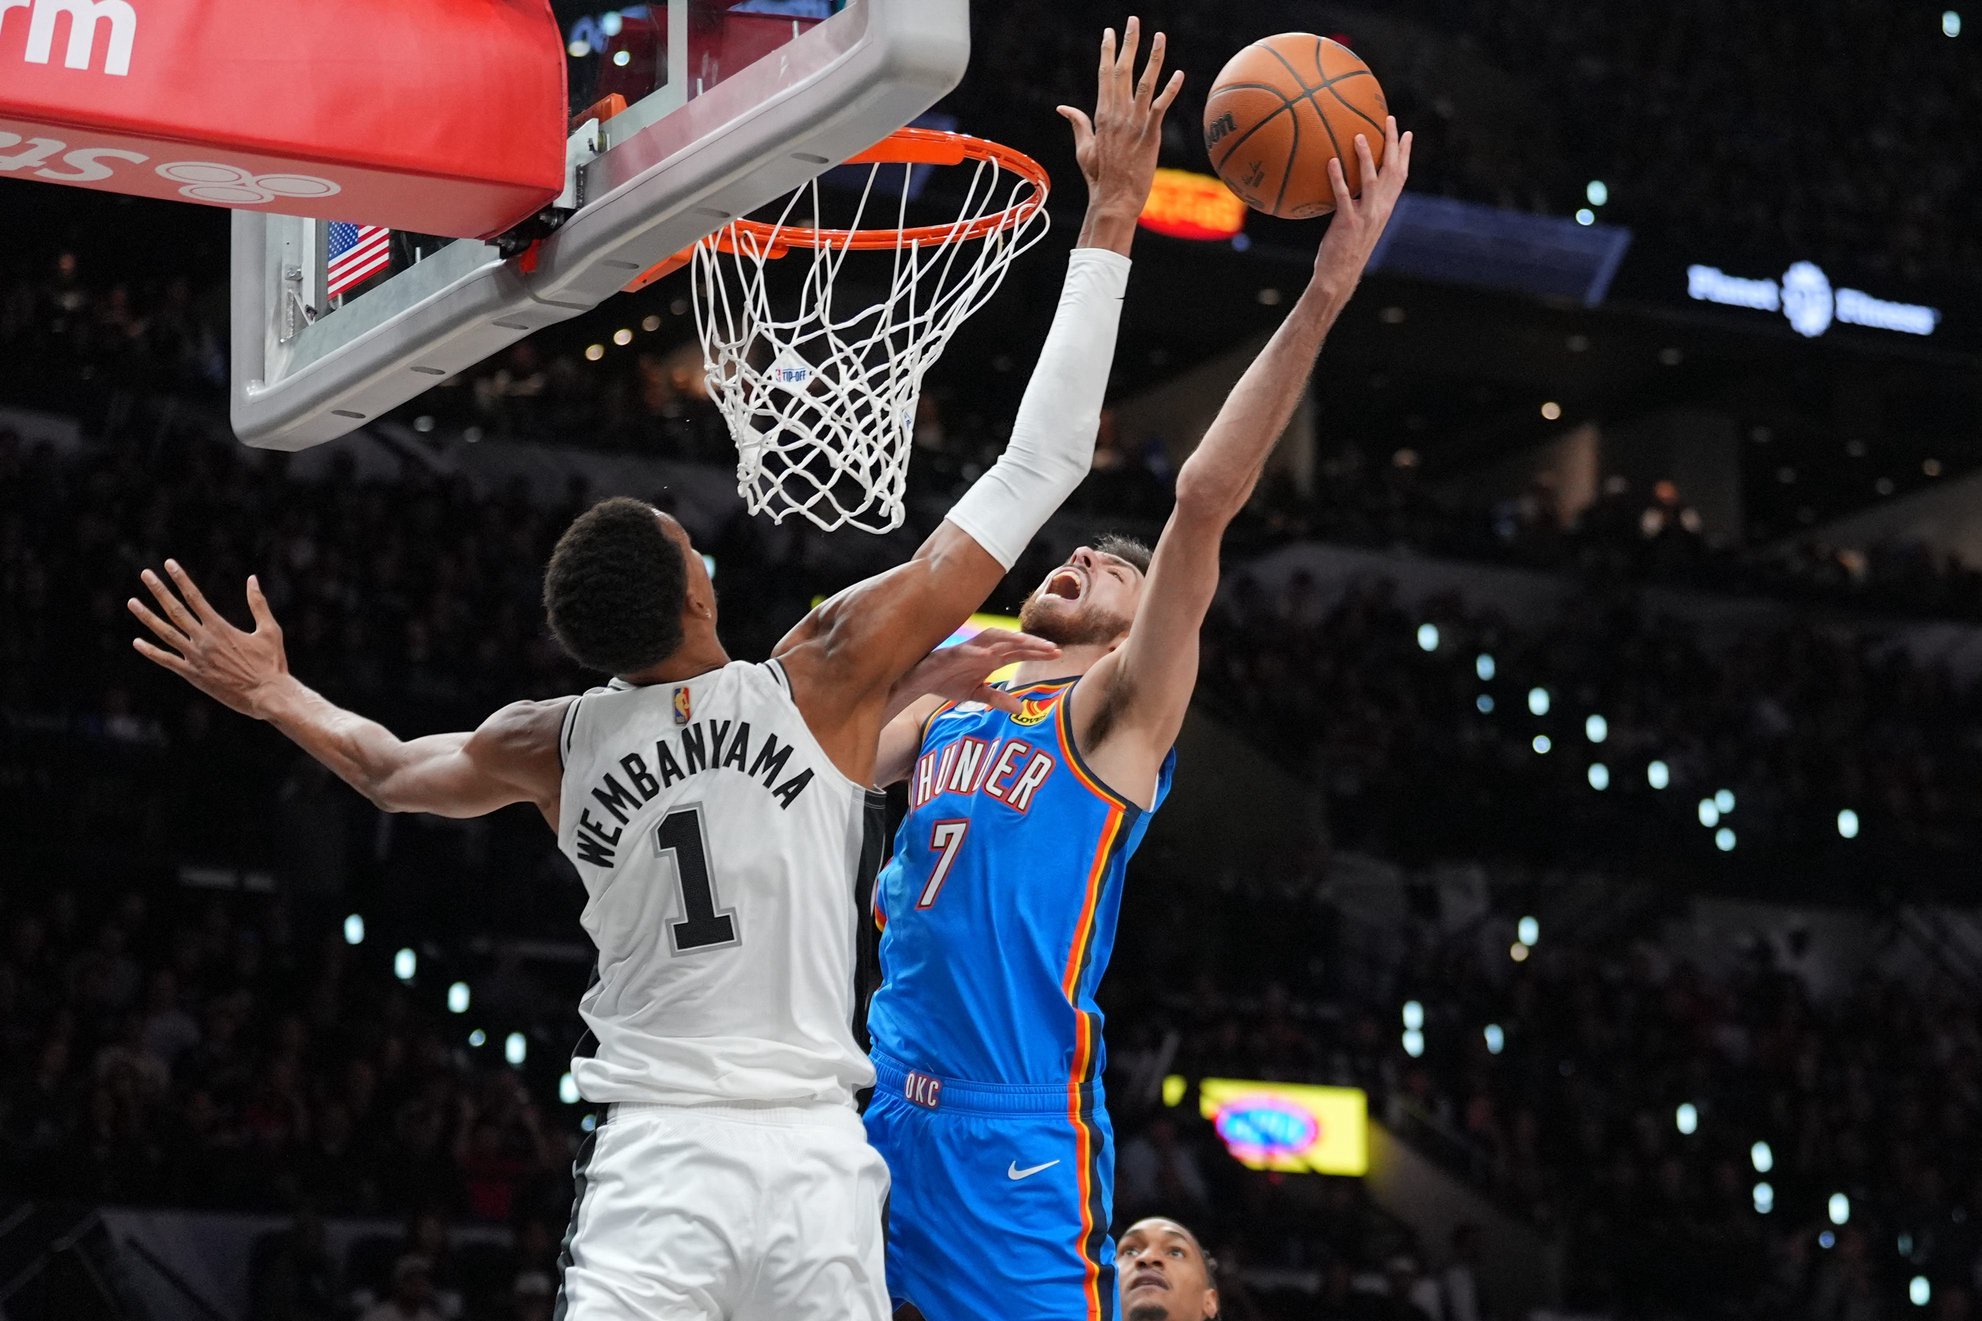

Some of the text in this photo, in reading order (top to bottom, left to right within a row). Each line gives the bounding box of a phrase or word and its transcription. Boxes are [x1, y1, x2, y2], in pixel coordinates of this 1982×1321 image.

[577, 719, 815, 868] WEMBANYAMA
[651, 801, 742, 957] 1
[915, 818, 971, 910] 7
[904, 1071, 941, 1107] OKC
